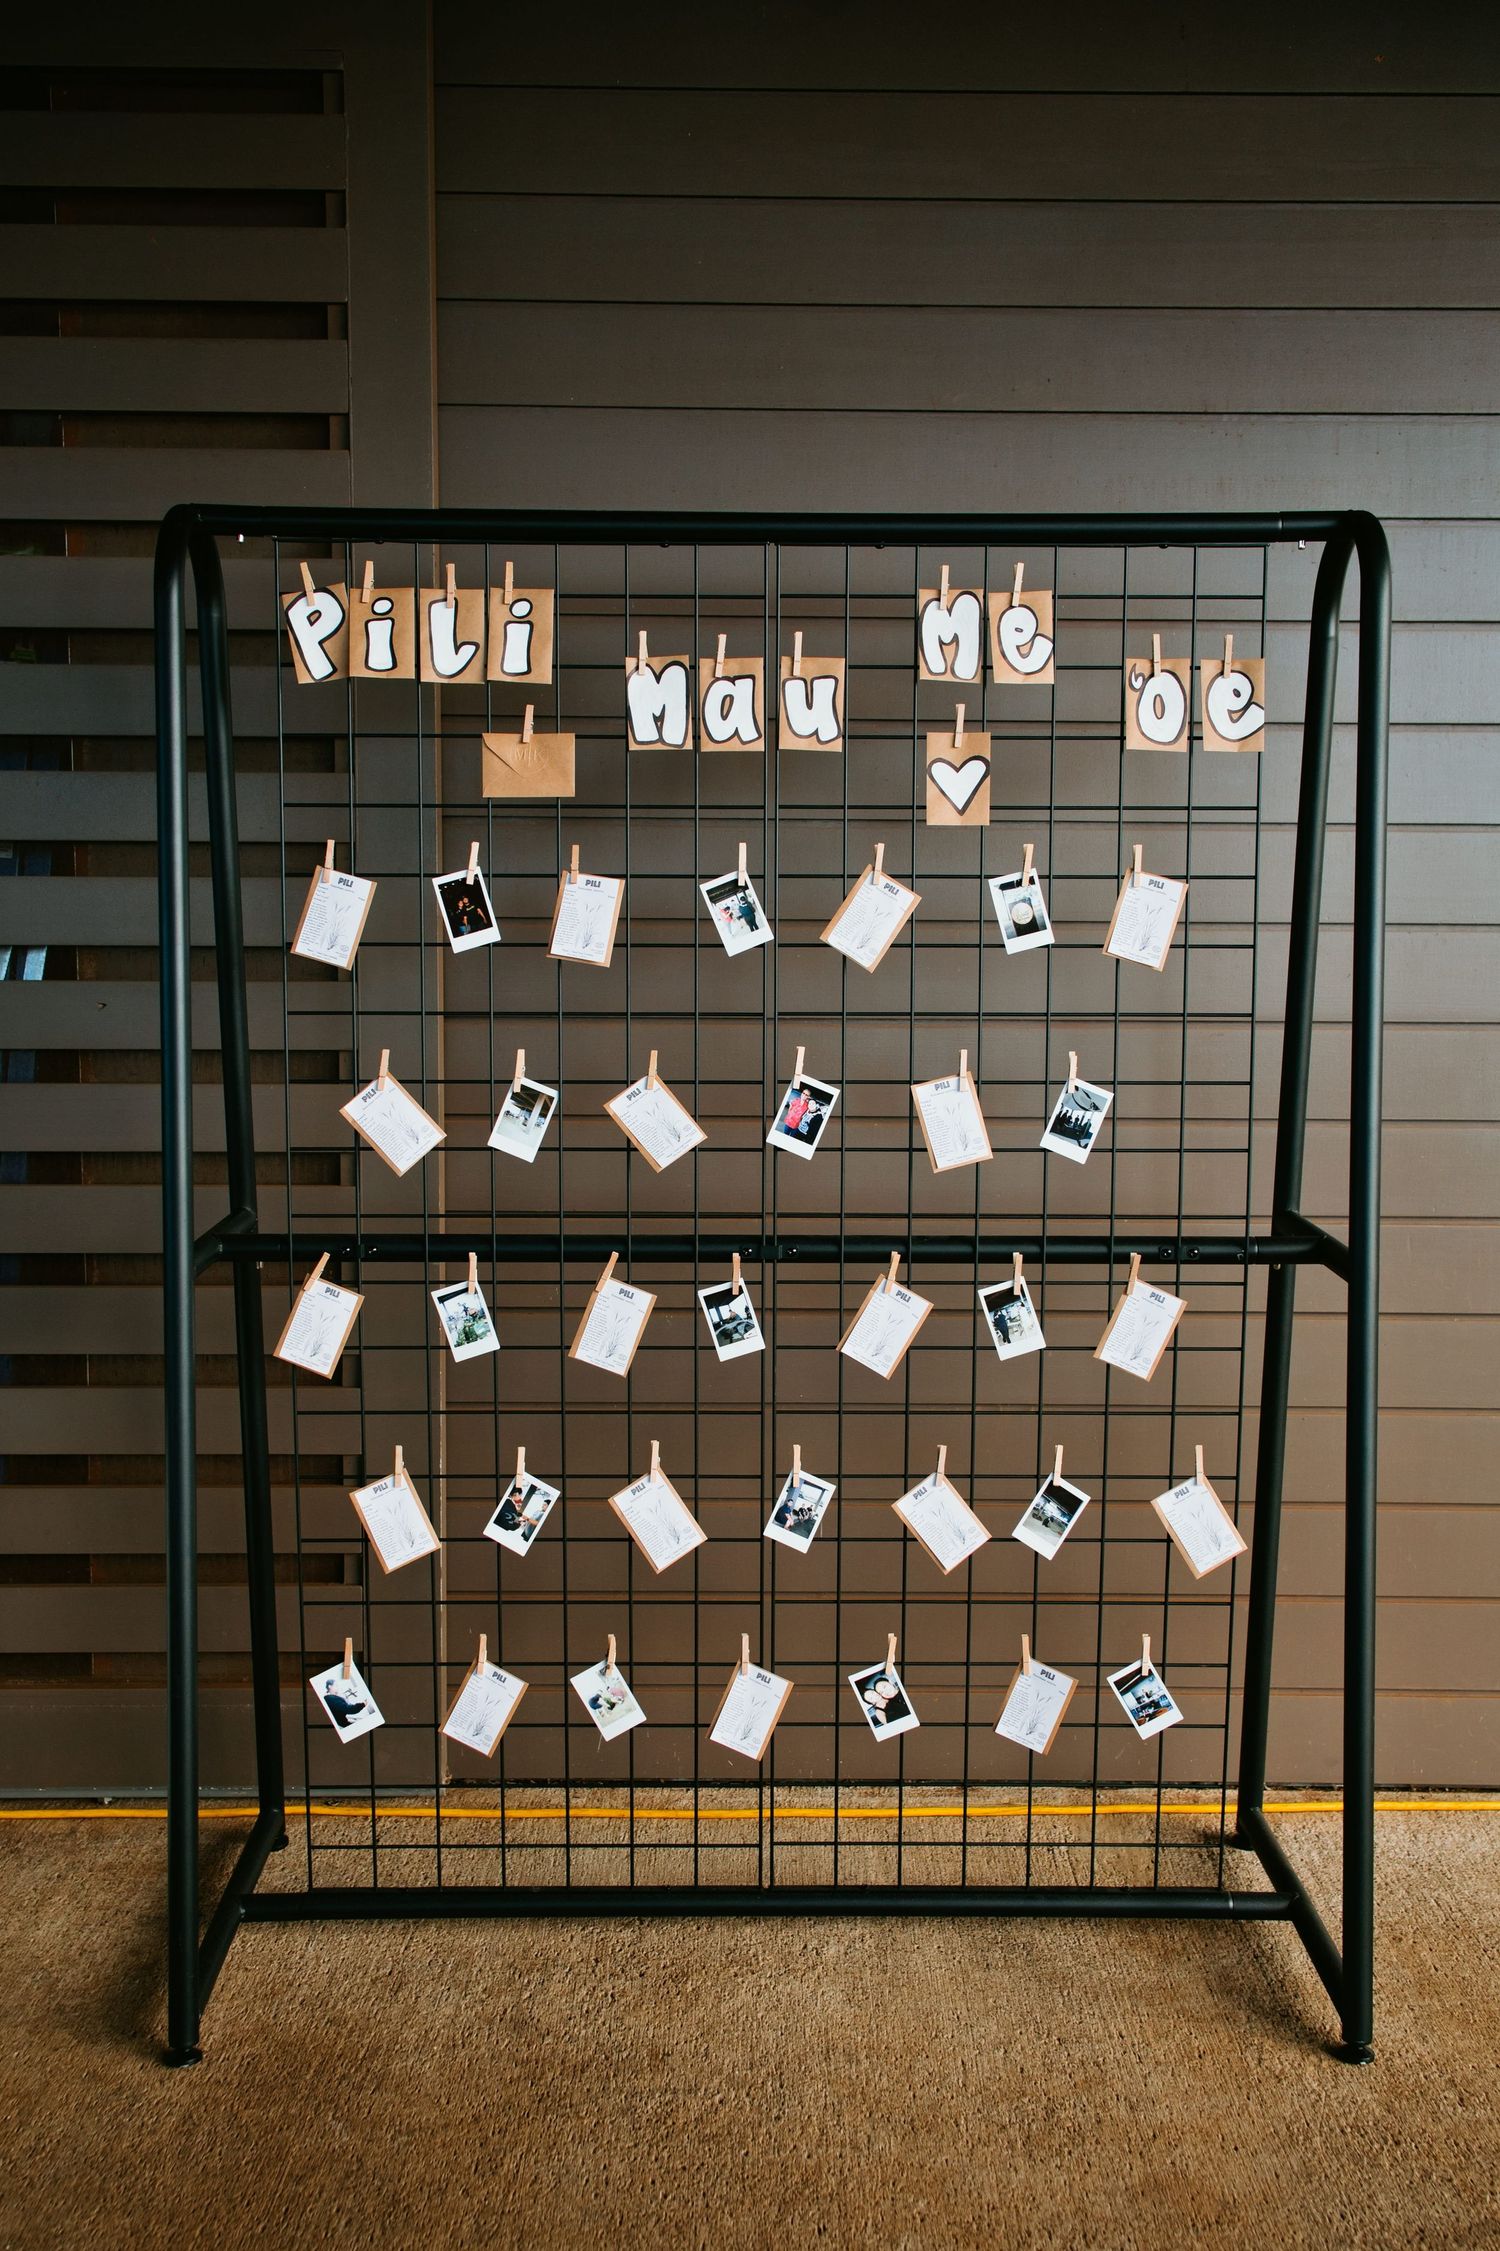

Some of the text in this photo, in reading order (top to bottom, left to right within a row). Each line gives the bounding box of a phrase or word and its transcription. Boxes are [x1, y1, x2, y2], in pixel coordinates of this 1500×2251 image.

[627, 660, 843, 748] Mau
[919, 591, 1054, 681] Me
[338, 877, 353, 887] PILI
[585, 879, 600, 888] PILI
[1149, 880, 1164, 889] PILI
[884, 883, 899, 895] PILI
[935, 1081, 950, 1090] PILI
[362, 1089, 376, 1102] PILI
[627, 1088, 641, 1100] PILI
[325, 1287, 340, 1297] PILI
[619, 1288, 634, 1299] PILI
[896, 1290, 911, 1302] PILI
[1150, 1292, 1165, 1303] PILI
[373, 1483, 388, 1493] PILI
[631, 1483, 645, 1495] PILI
[913, 1487, 927, 1499] PILI
[1175, 1486, 1189, 1498] PILI
[492, 1671, 506, 1683] PILI
[756, 1673, 771, 1684] PILI
[1040, 1669, 1055, 1680] PILI
